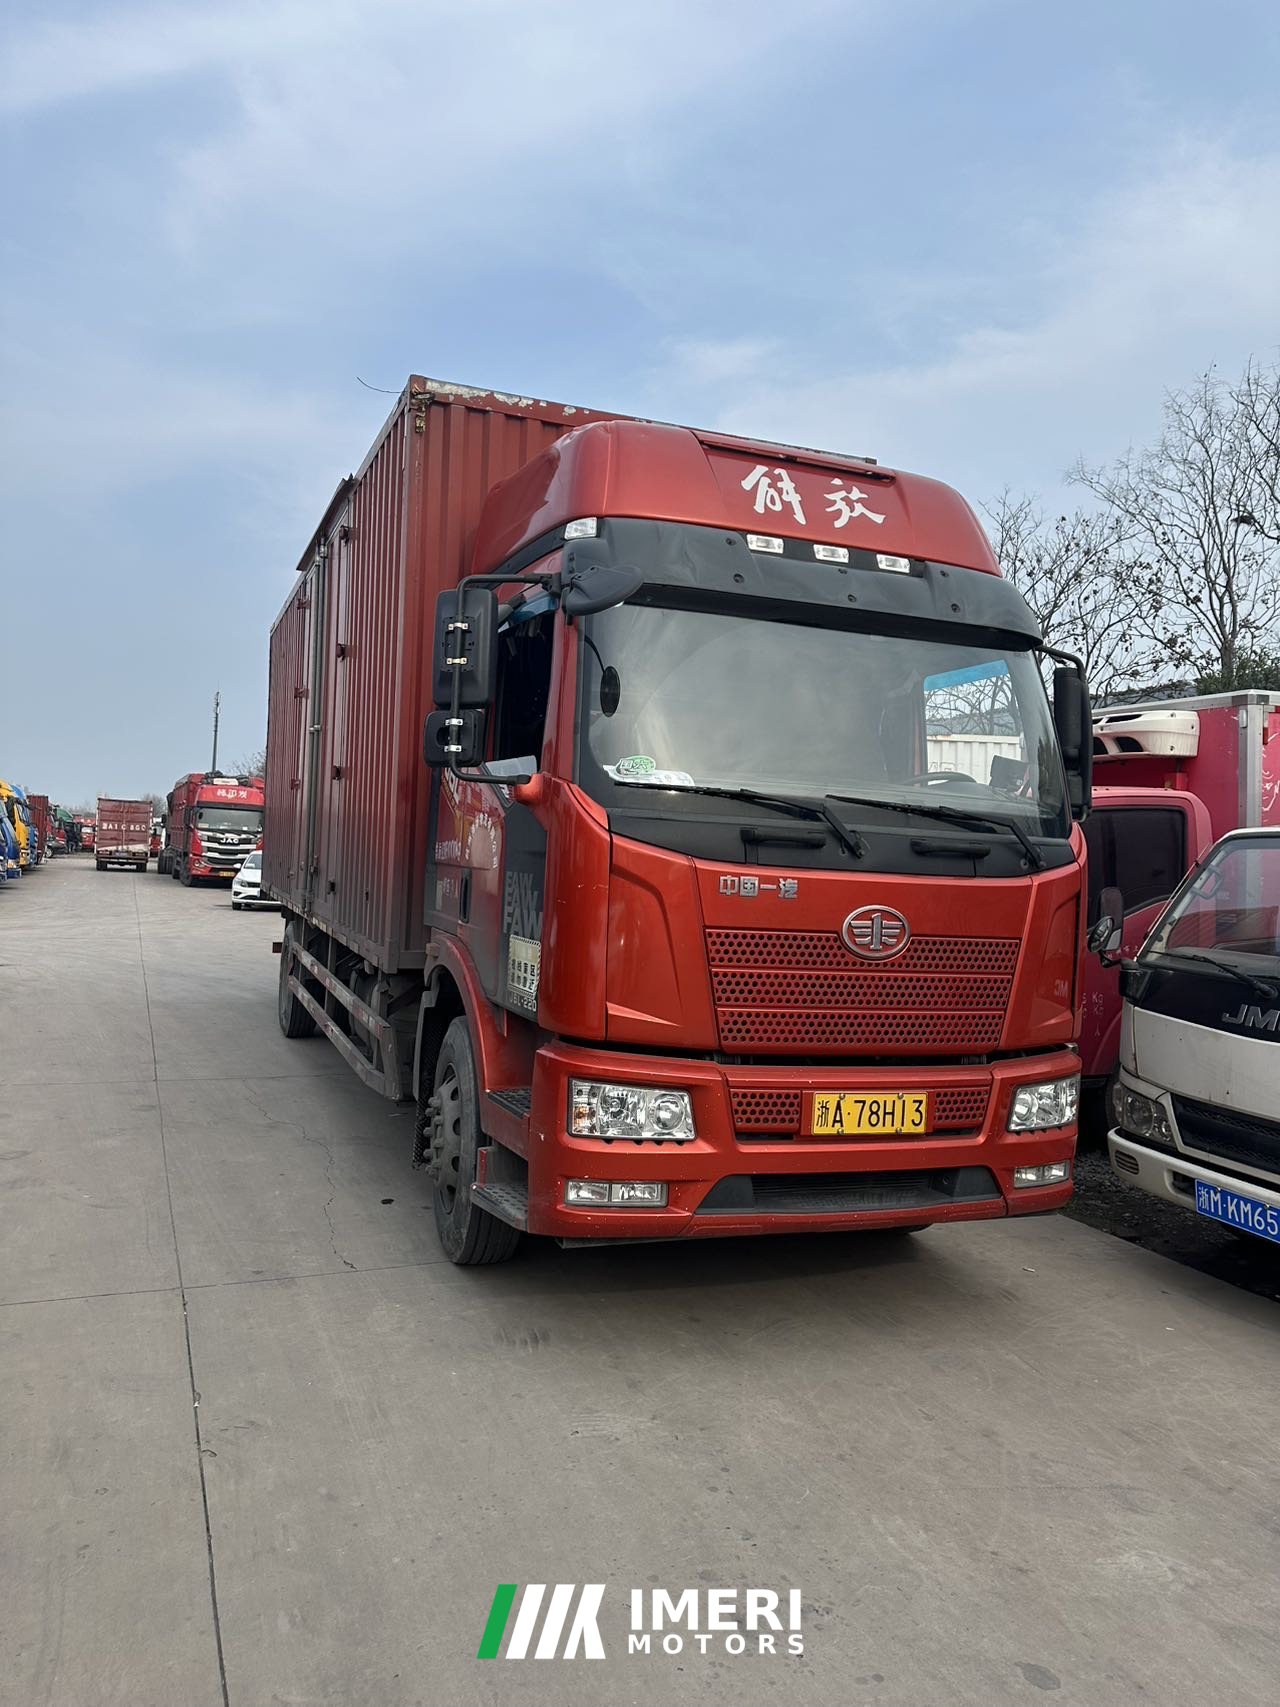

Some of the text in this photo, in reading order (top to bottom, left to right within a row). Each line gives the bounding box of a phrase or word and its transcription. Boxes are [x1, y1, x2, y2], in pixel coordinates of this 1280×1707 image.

[719, 875, 798, 899] 中国一汽
[503, 906, 544, 940] FAW
[1222, 1004, 1280, 1031] JM
[816, 1100, 923, 1127] 浙A·78H13
